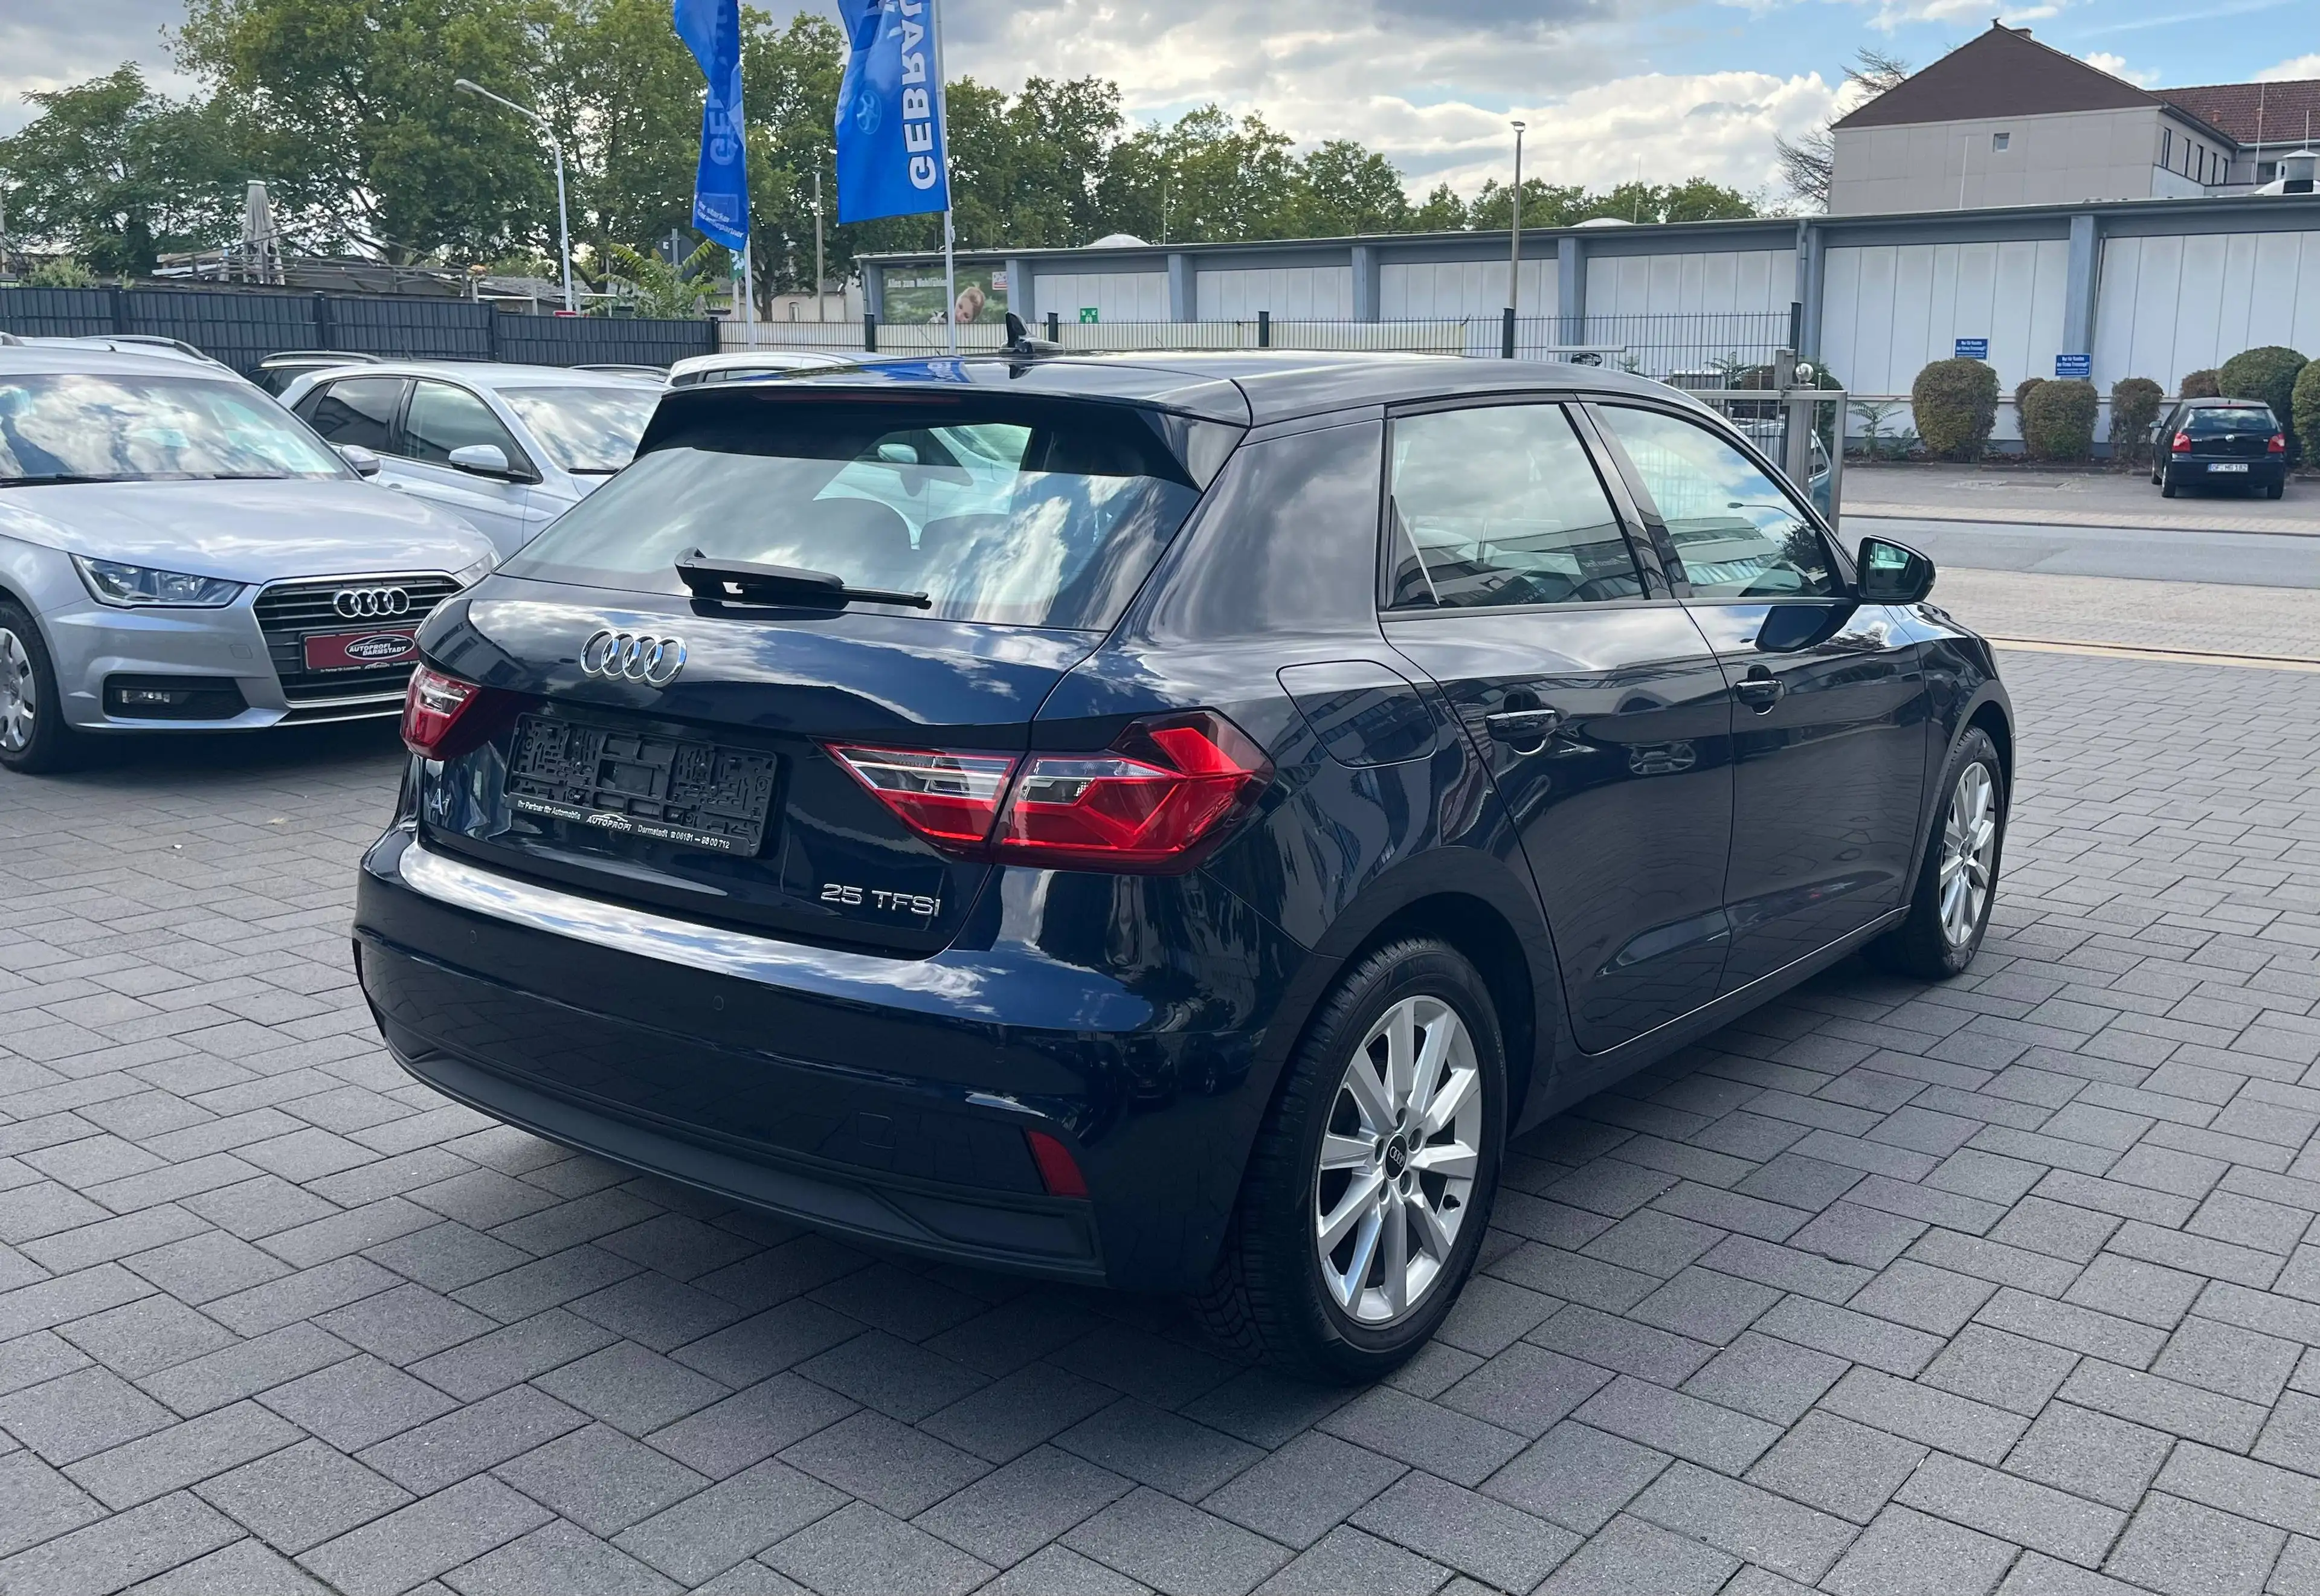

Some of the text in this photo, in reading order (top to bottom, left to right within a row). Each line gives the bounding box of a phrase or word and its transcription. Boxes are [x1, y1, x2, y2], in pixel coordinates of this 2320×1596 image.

[349, 643, 391, 653] AUTOPROFI
[362, 646, 407, 656] DARMSTADT
[430, 788, 450, 816] A1
[524, 801, 544, 812] Partner
[585, 816, 633, 832] AUTOPROFI
[637, 824, 668, 838] Darmstadt
[820, 883, 941, 917] 25 TFSI
